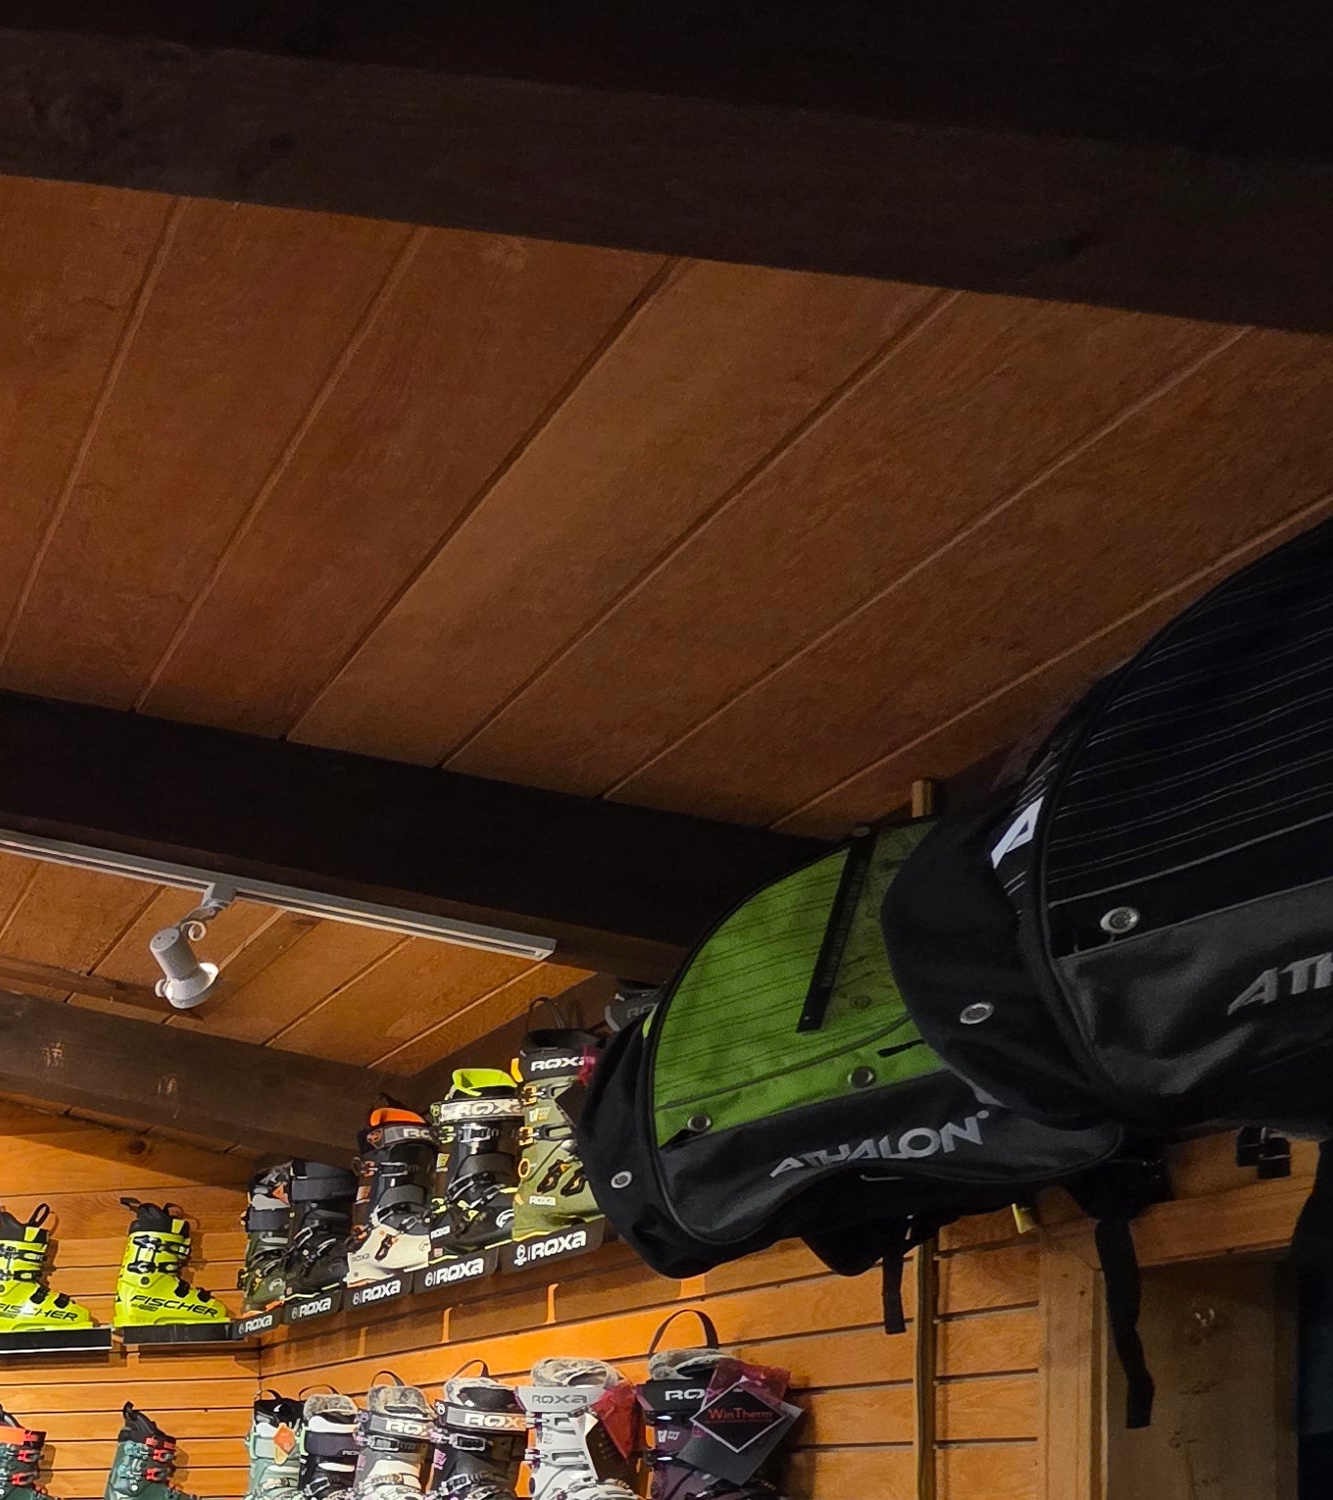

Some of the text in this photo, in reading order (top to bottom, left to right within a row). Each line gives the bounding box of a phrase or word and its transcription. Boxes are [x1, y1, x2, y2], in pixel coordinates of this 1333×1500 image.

[769, 1113, 986, 1179] ATHALON
[130, 1294, 219, 1317] FISCHER
[707, 1407, 774, 1422] WinTherm
